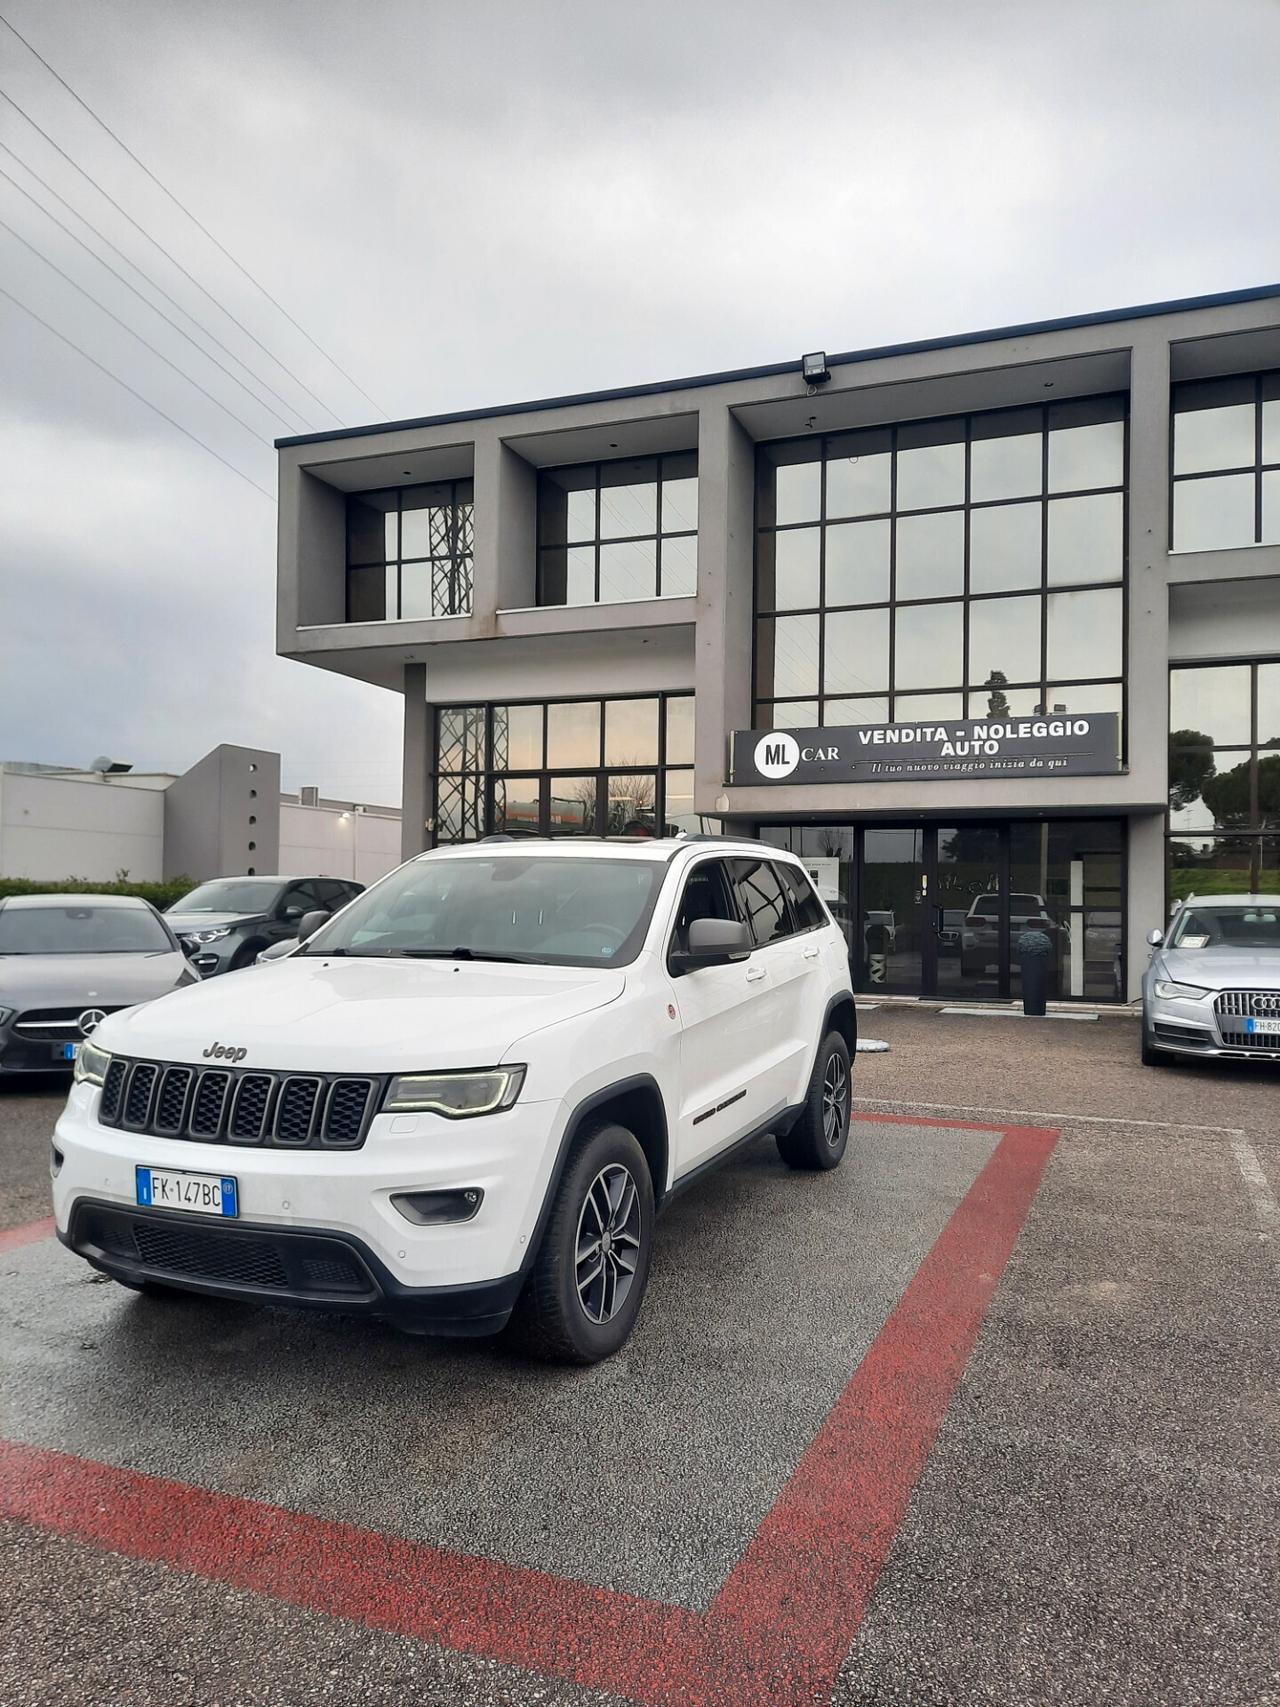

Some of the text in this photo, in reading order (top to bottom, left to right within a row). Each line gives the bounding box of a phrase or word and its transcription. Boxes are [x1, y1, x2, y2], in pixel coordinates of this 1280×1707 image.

[858, 727, 949, 745] VENDITA
[973, 719, 1090, 740] NOLEGGIO
[765, 743, 840, 766] ML CAR
[940, 739, 1000, 757] AUTO
[872, 756, 1068, 773] Il tuo nuovo viaggio inizia da qui
[203, 1041, 248, 1063] Jeep
